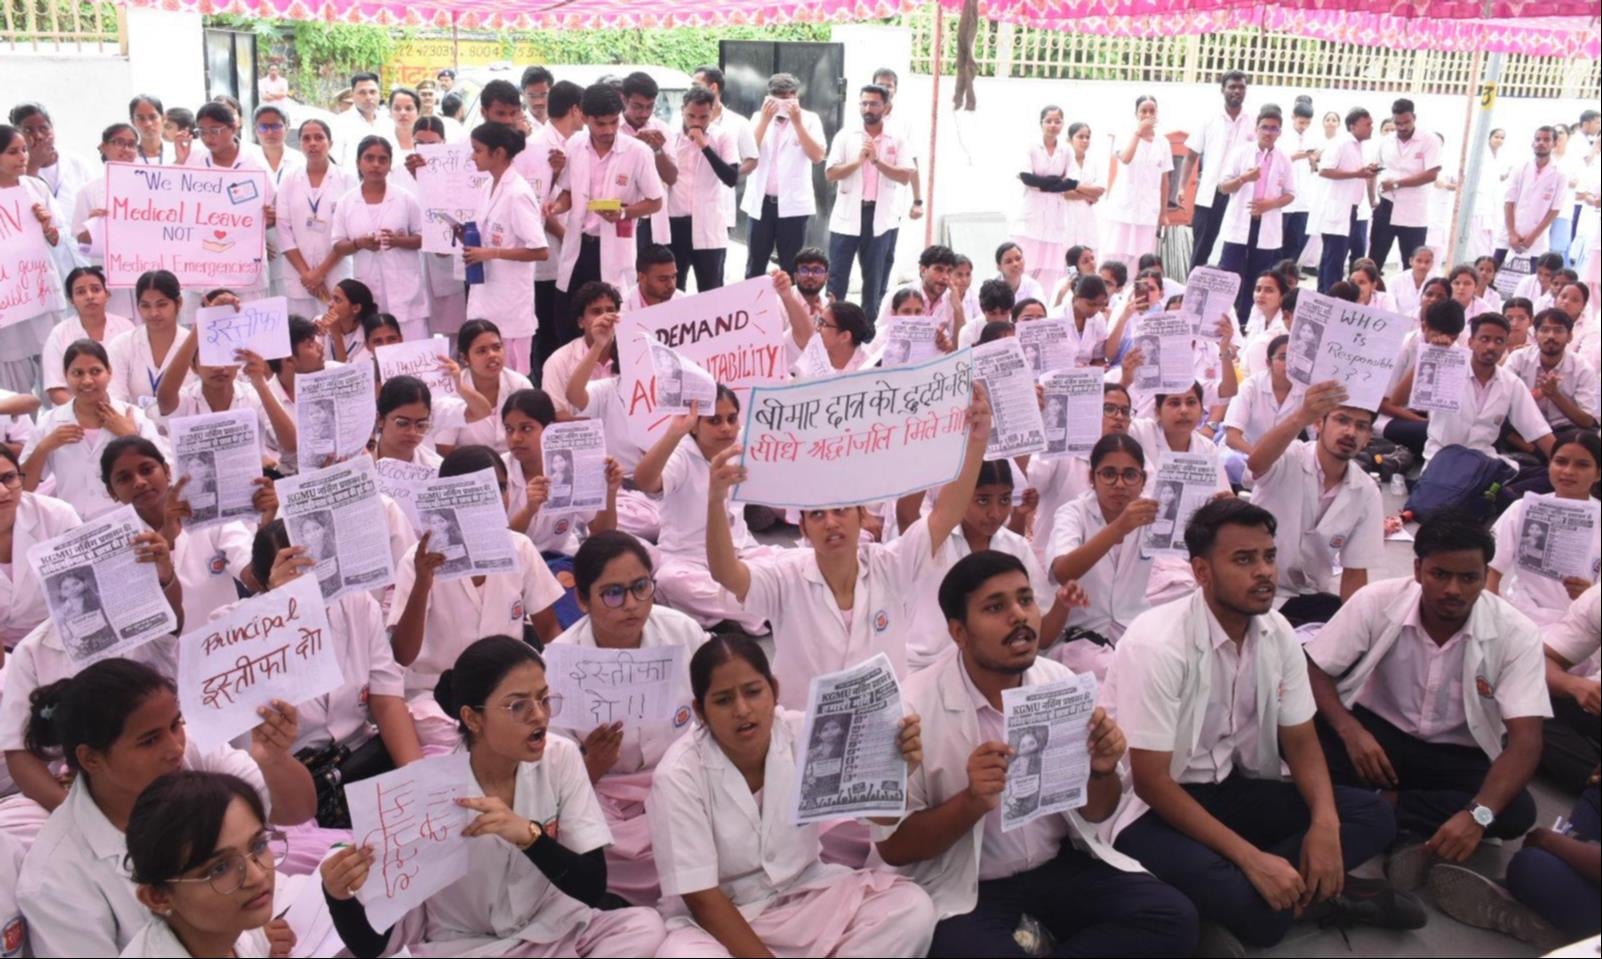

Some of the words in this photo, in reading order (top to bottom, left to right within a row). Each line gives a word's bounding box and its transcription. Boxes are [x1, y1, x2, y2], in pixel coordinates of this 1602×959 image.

[1481, 85, 1494, 106] 3
[180, 172, 223, 194] Need
[112, 196, 184, 223] Medical
[195, 202, 254, 228] Leave
[162, 226, 194, 242] NOT
[110, 253, 164, 273] Medical
[655, 310, 748, 347] DEMAND
[1340, 309, 1387, 331] WHO
[1353, 333, 1367, 347] is
[1327, 341, 1394, 369] Responsible
[756, 398, 820, 430] बीमार
[751, 432, 806, 462] सीधे
[202, 597, 299, 656] Principal
[202, 644, 290, 709] इस्तीफा
[569, 651, 672, 688] इस्तीफा
[1013, 702, 1041, 716] KGMU
